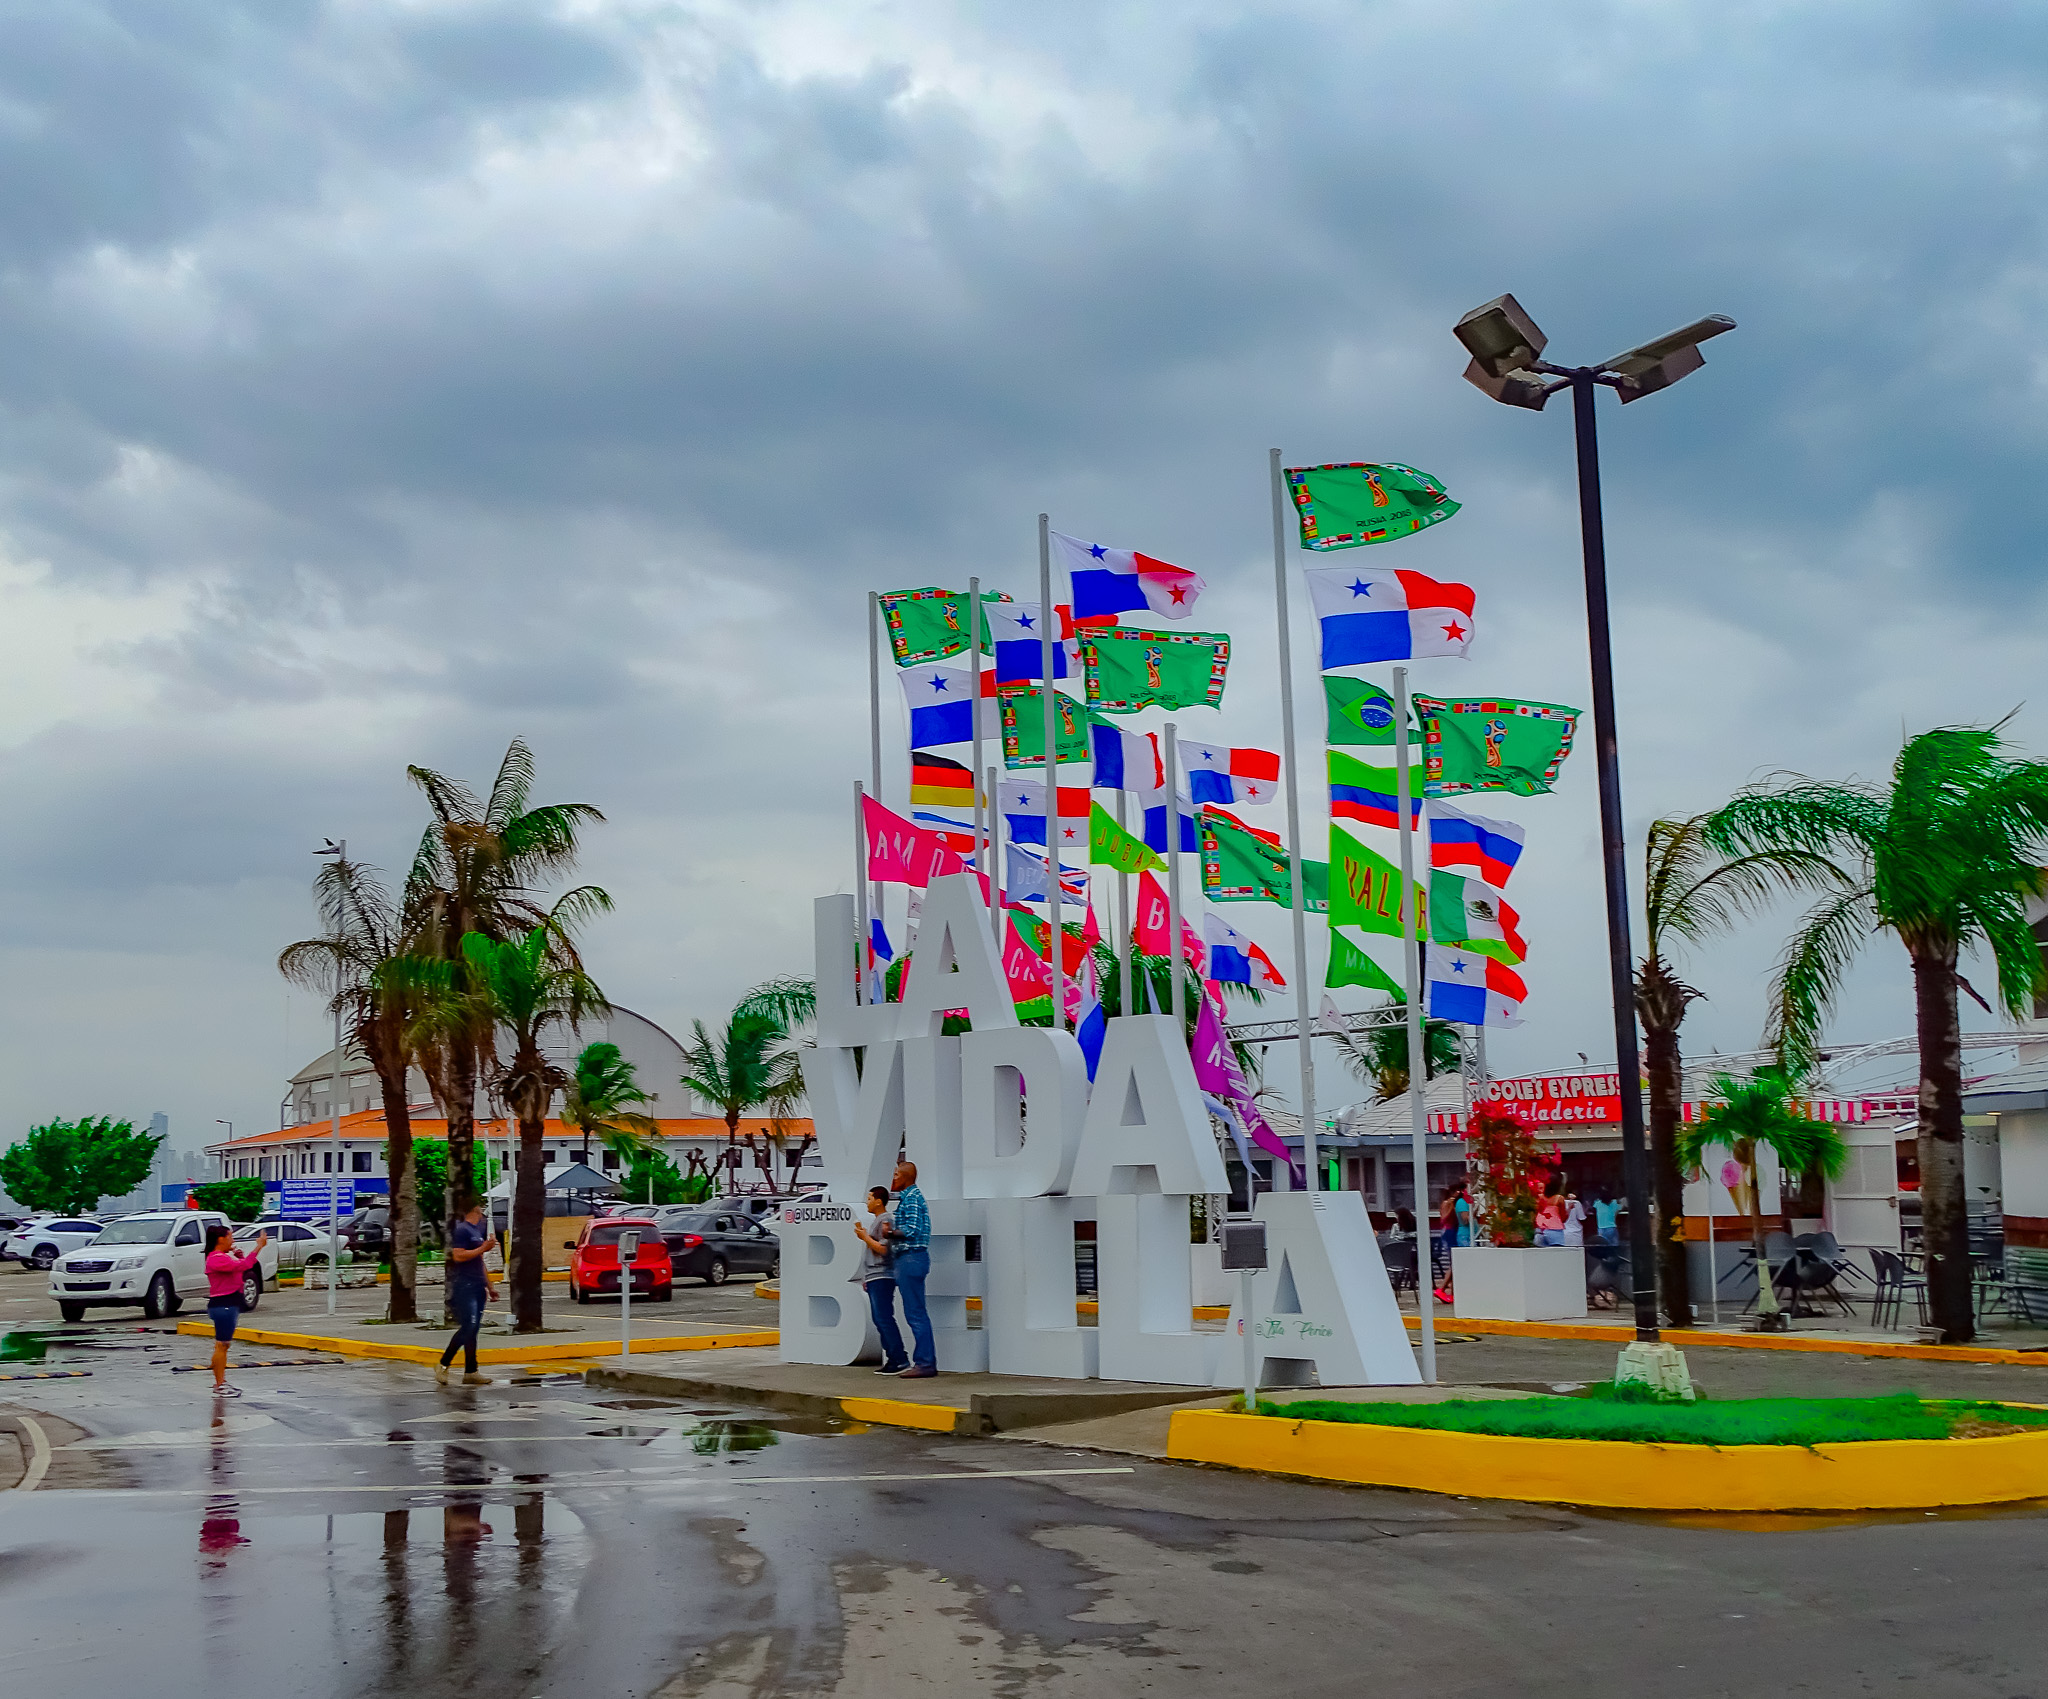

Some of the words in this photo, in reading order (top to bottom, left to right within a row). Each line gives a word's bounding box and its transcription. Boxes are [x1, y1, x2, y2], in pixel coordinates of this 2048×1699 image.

[1356, 515, 1387, 527] RUSIA
[1390, 509, 1411, 521] 2018
[875, 830, 969, 877] AMO
[815, 873, 1018, 1048] LA
[801, 1013, 1231, 1200] VIDA
[794, 1207, 851, 1225] @ISLAPERICO
